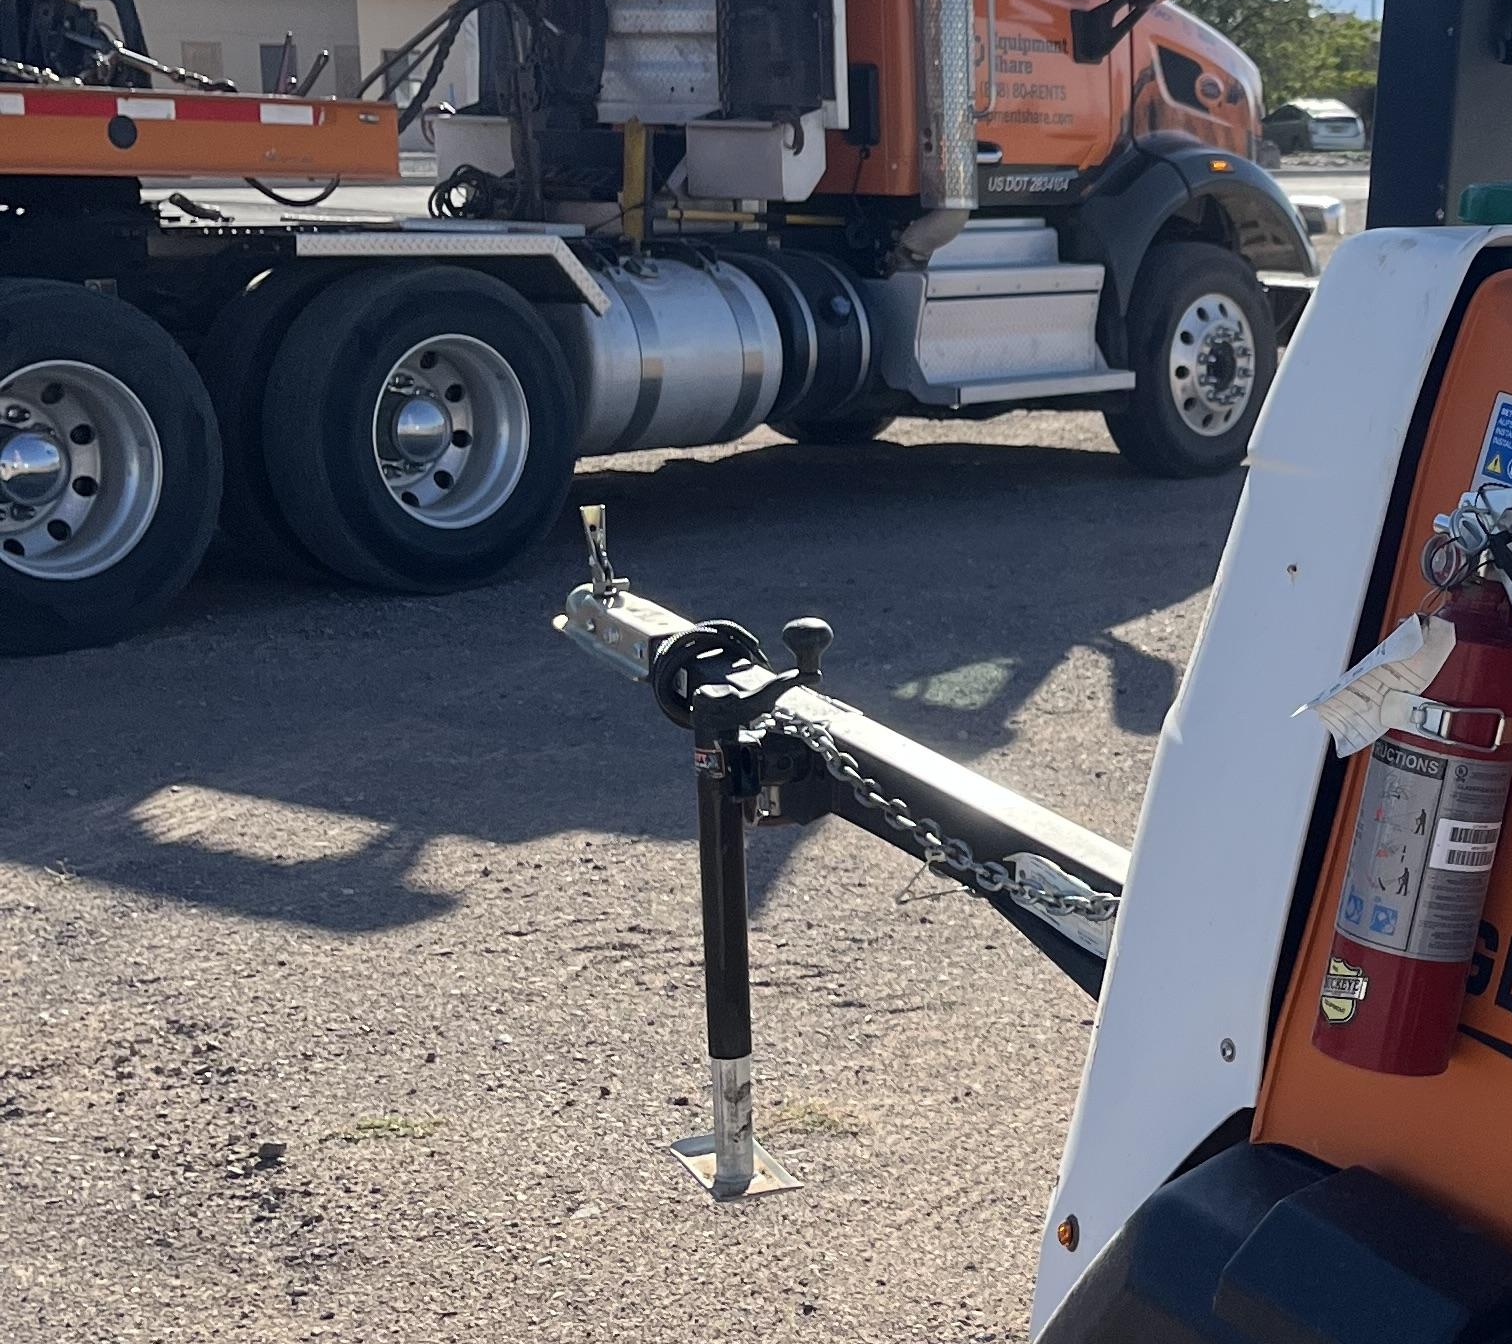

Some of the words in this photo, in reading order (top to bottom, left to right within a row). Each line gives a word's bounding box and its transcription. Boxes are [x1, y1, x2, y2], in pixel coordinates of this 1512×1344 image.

[995, 55, 1032, 74] hare
[985, 107, 1073, 125] pmentshare.com
[988, 176, 1004, 192] US
[1005, 176, 1029, 192] DOT
